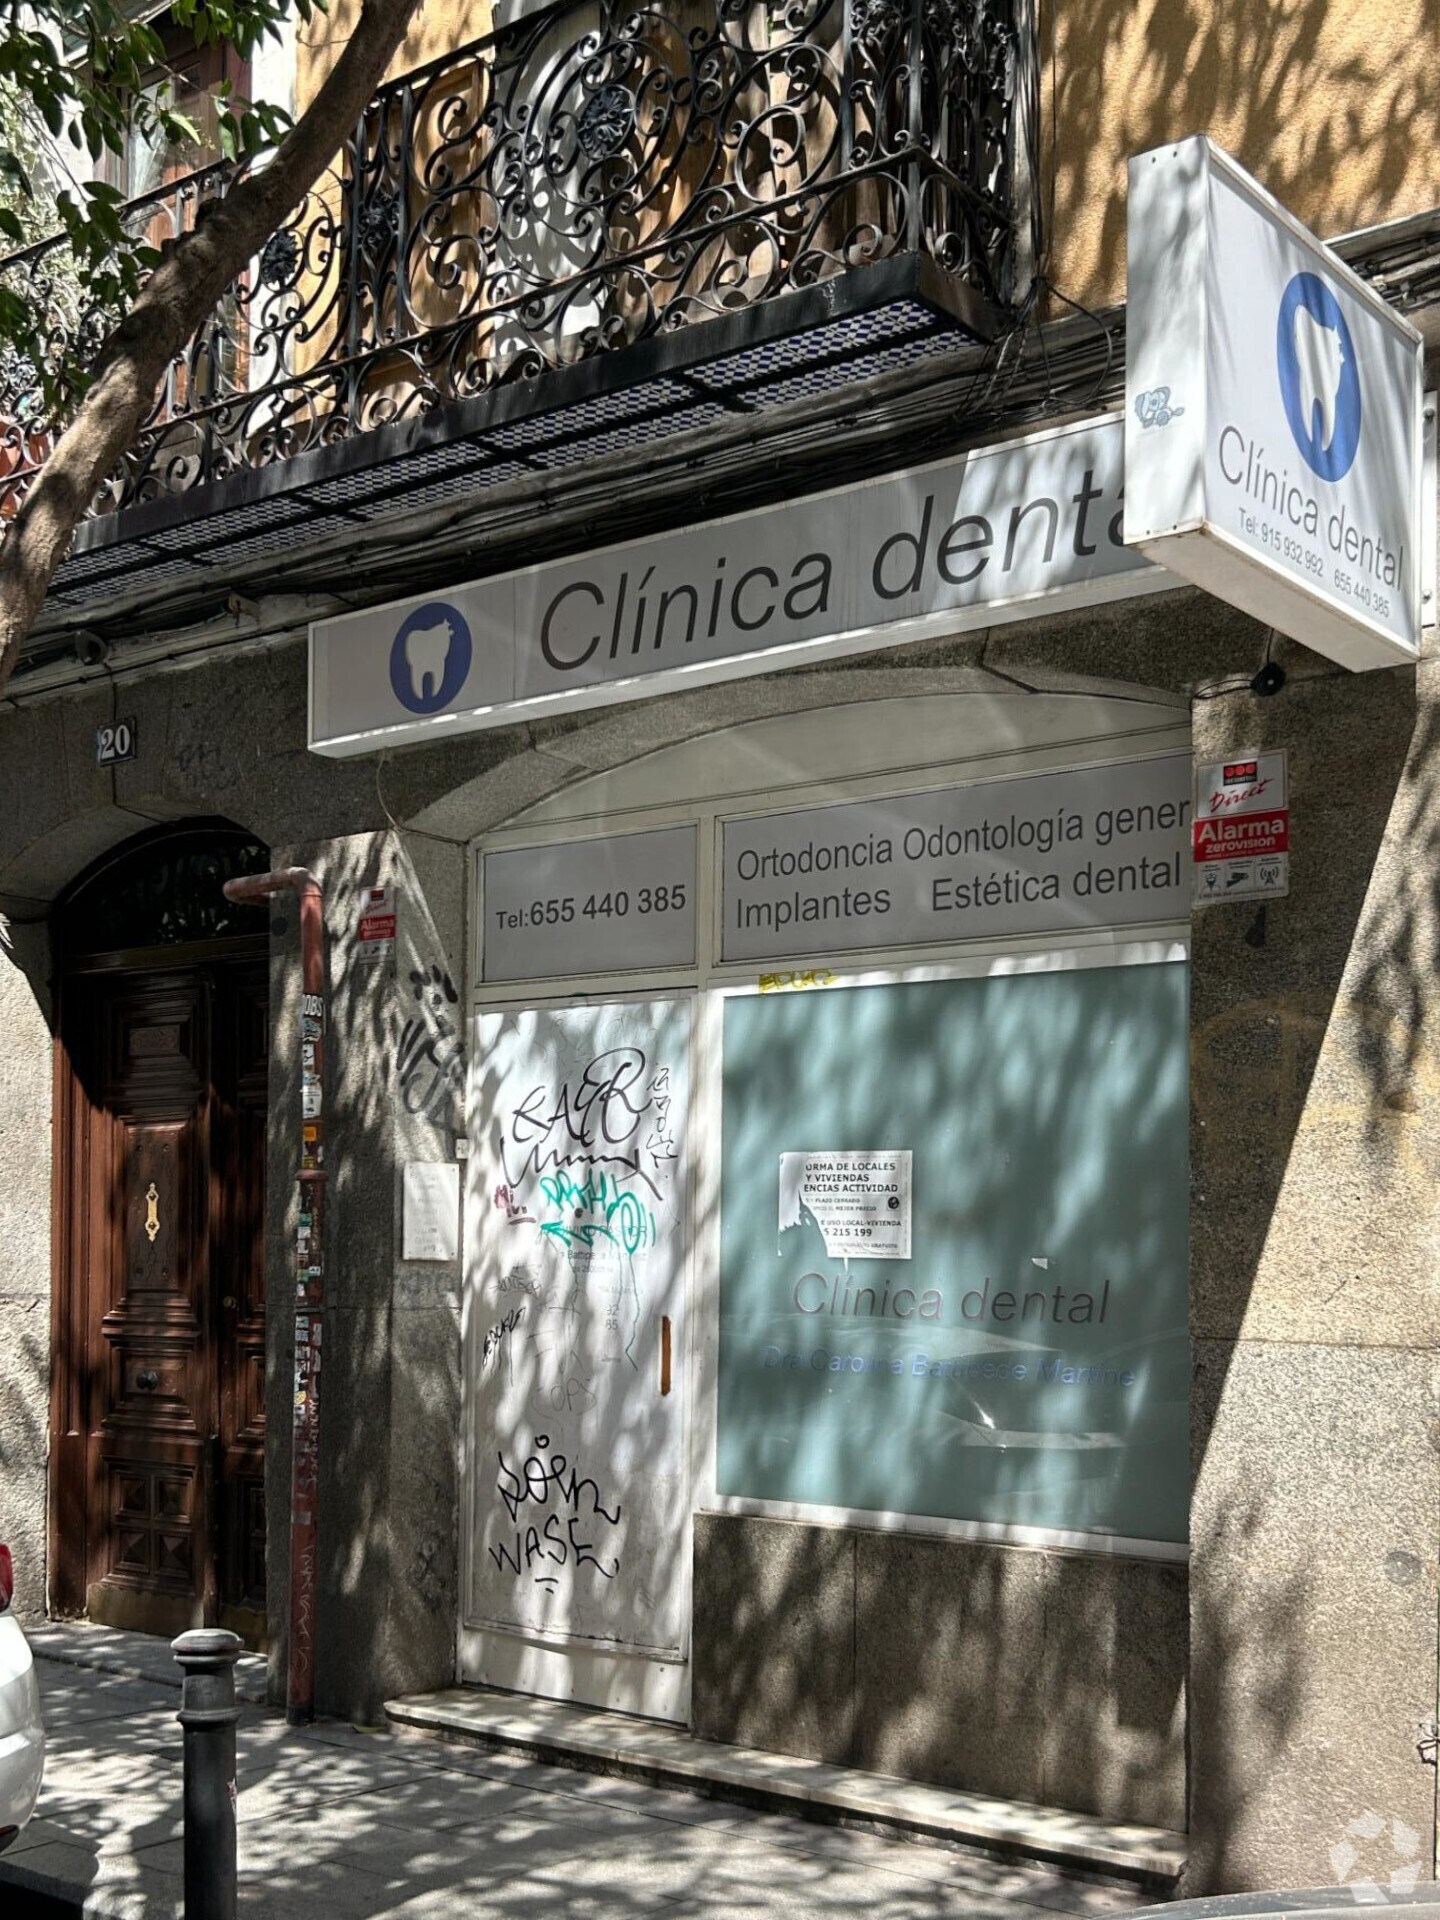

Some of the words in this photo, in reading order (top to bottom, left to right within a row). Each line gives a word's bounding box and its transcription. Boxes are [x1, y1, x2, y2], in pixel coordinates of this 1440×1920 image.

[1218, 425, 1319, 537] Clínica
[1328, 505, 1404, 592] dental
[540, 553, 832, 671] Clínica
[872, 470, 1124, 600] dent
[1238, 507, 1259, 536] Tel:
[1261, 523, 1281, 551] 915
[1284, 537, 1303, 564] 932
[1305, 550, 1324, 578] 992
[1334, 568, 1352, 594] 655
[1353, 582, 1371, 606] 440
[1373, 593, 1390, 618] 385
[101, 725, 131, 759] 20
[1210, 778, 1275, 813] Direct
[737, 833, 892, 880] Ortodoncia
[903, 808, 1083, 860] Odontología
[1198, 818, 1284, 844] Alarma
[1206, 835, 1276, 854] zerovision
[582, 891, 629, 919] 440
[637, 884, 687, 914] 385
[737, 887, 891, 932] Implantes
[932, 872, 1060, 911] Estética
[1072, 851, 1181, 896] dental
[806, 1174, 812, 1182] Y
[814, 1174, 870, 1182] VIVIENDAS
[836, 1163, 849, 1171] DE
[852, 1162, 896, 1171] LOCALES
[804, 1184, 840, 1192] ENCIAS
[842, 1184, 898, 1192] ACTIVIDAD
[833, 1228, 851, 1236] 215
[854, 1228, 873, 1237] 199
[793, 1272, 943, 1320] Clínica
[960, 1277, 1110, 1324] dental
